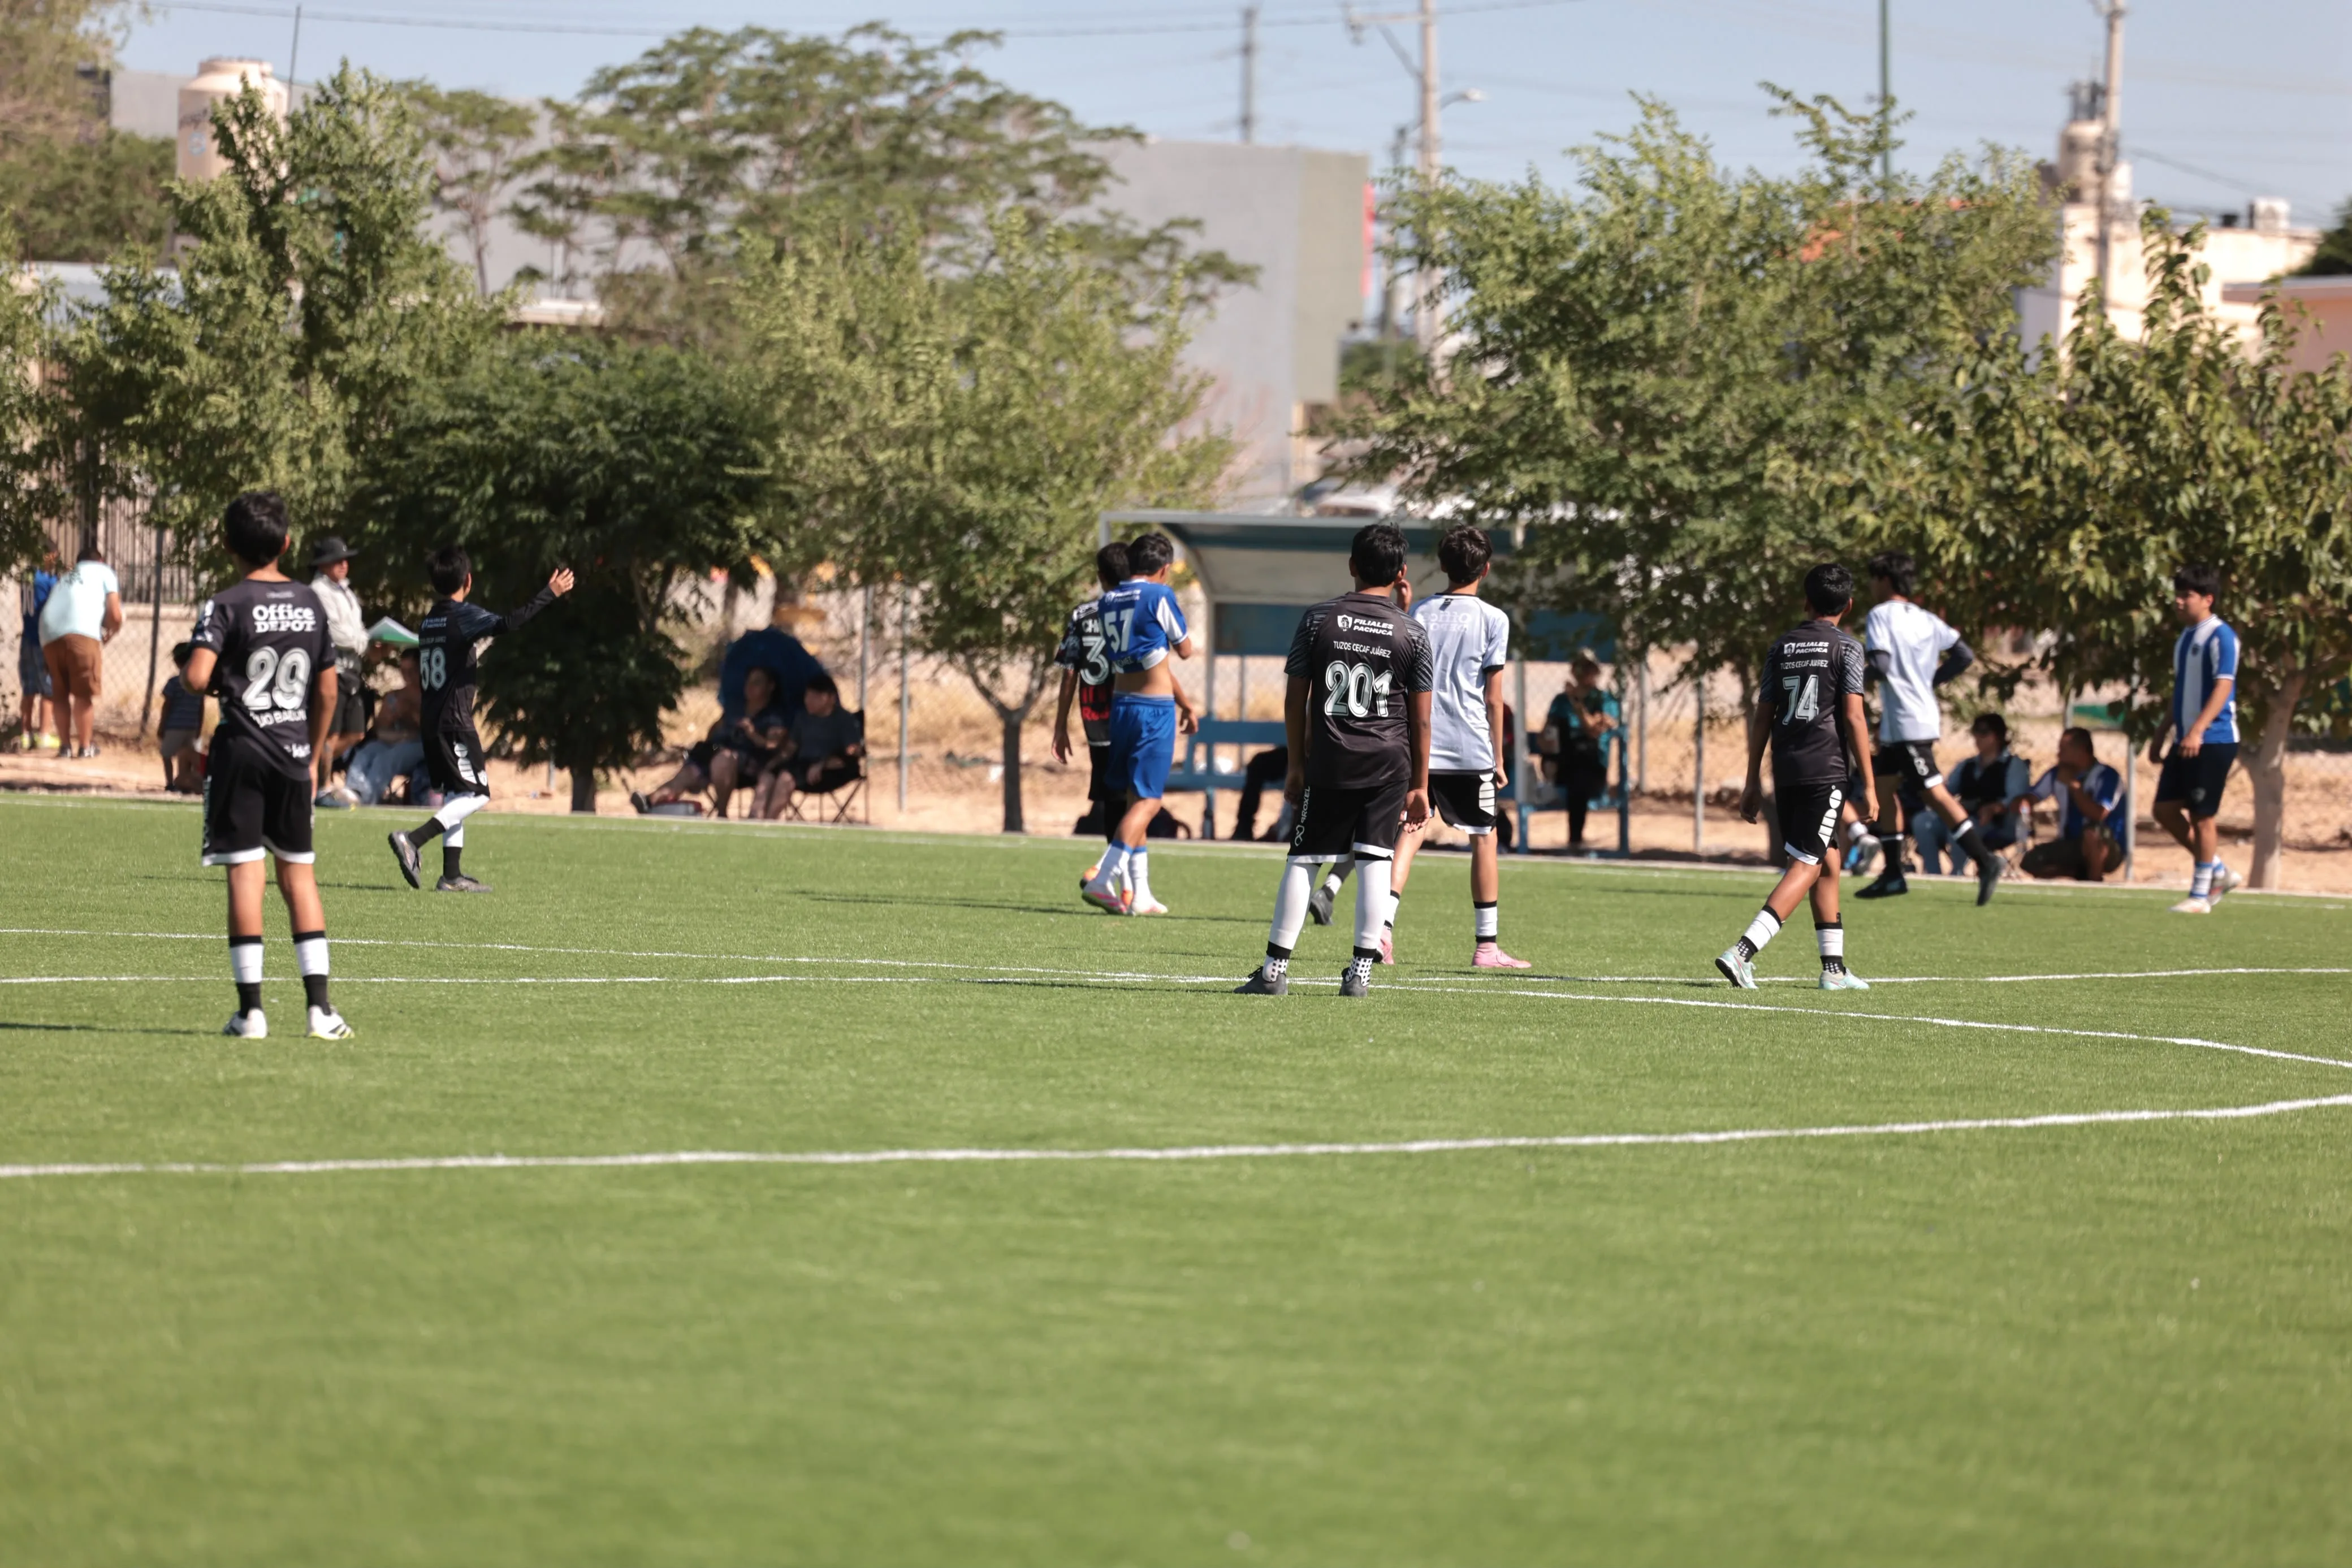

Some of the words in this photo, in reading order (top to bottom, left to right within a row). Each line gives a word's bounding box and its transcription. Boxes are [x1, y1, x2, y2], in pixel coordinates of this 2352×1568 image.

[253, 604, 314, 621] Office
[254, 620, 316, 633] DEPOT
[1104, 608, 1135, 653] 57
[1353, 626, 1393, 636] PACHUCA
[1354, 618, 1394, 630] FILIALES
[420, 646, 447, 691] 58
[1080, 635, 1110, 686] 3
[1333, 640, 1351, 650] TUZOS
[1352, 643, 1370, 653] CECAF
[1371, 646, 1392, 659] JUÁREZ
[241, 645, 311, 710] 29
[1325, 660, 1394, 718] 201
[1782, 674, 1819, 726] 74
